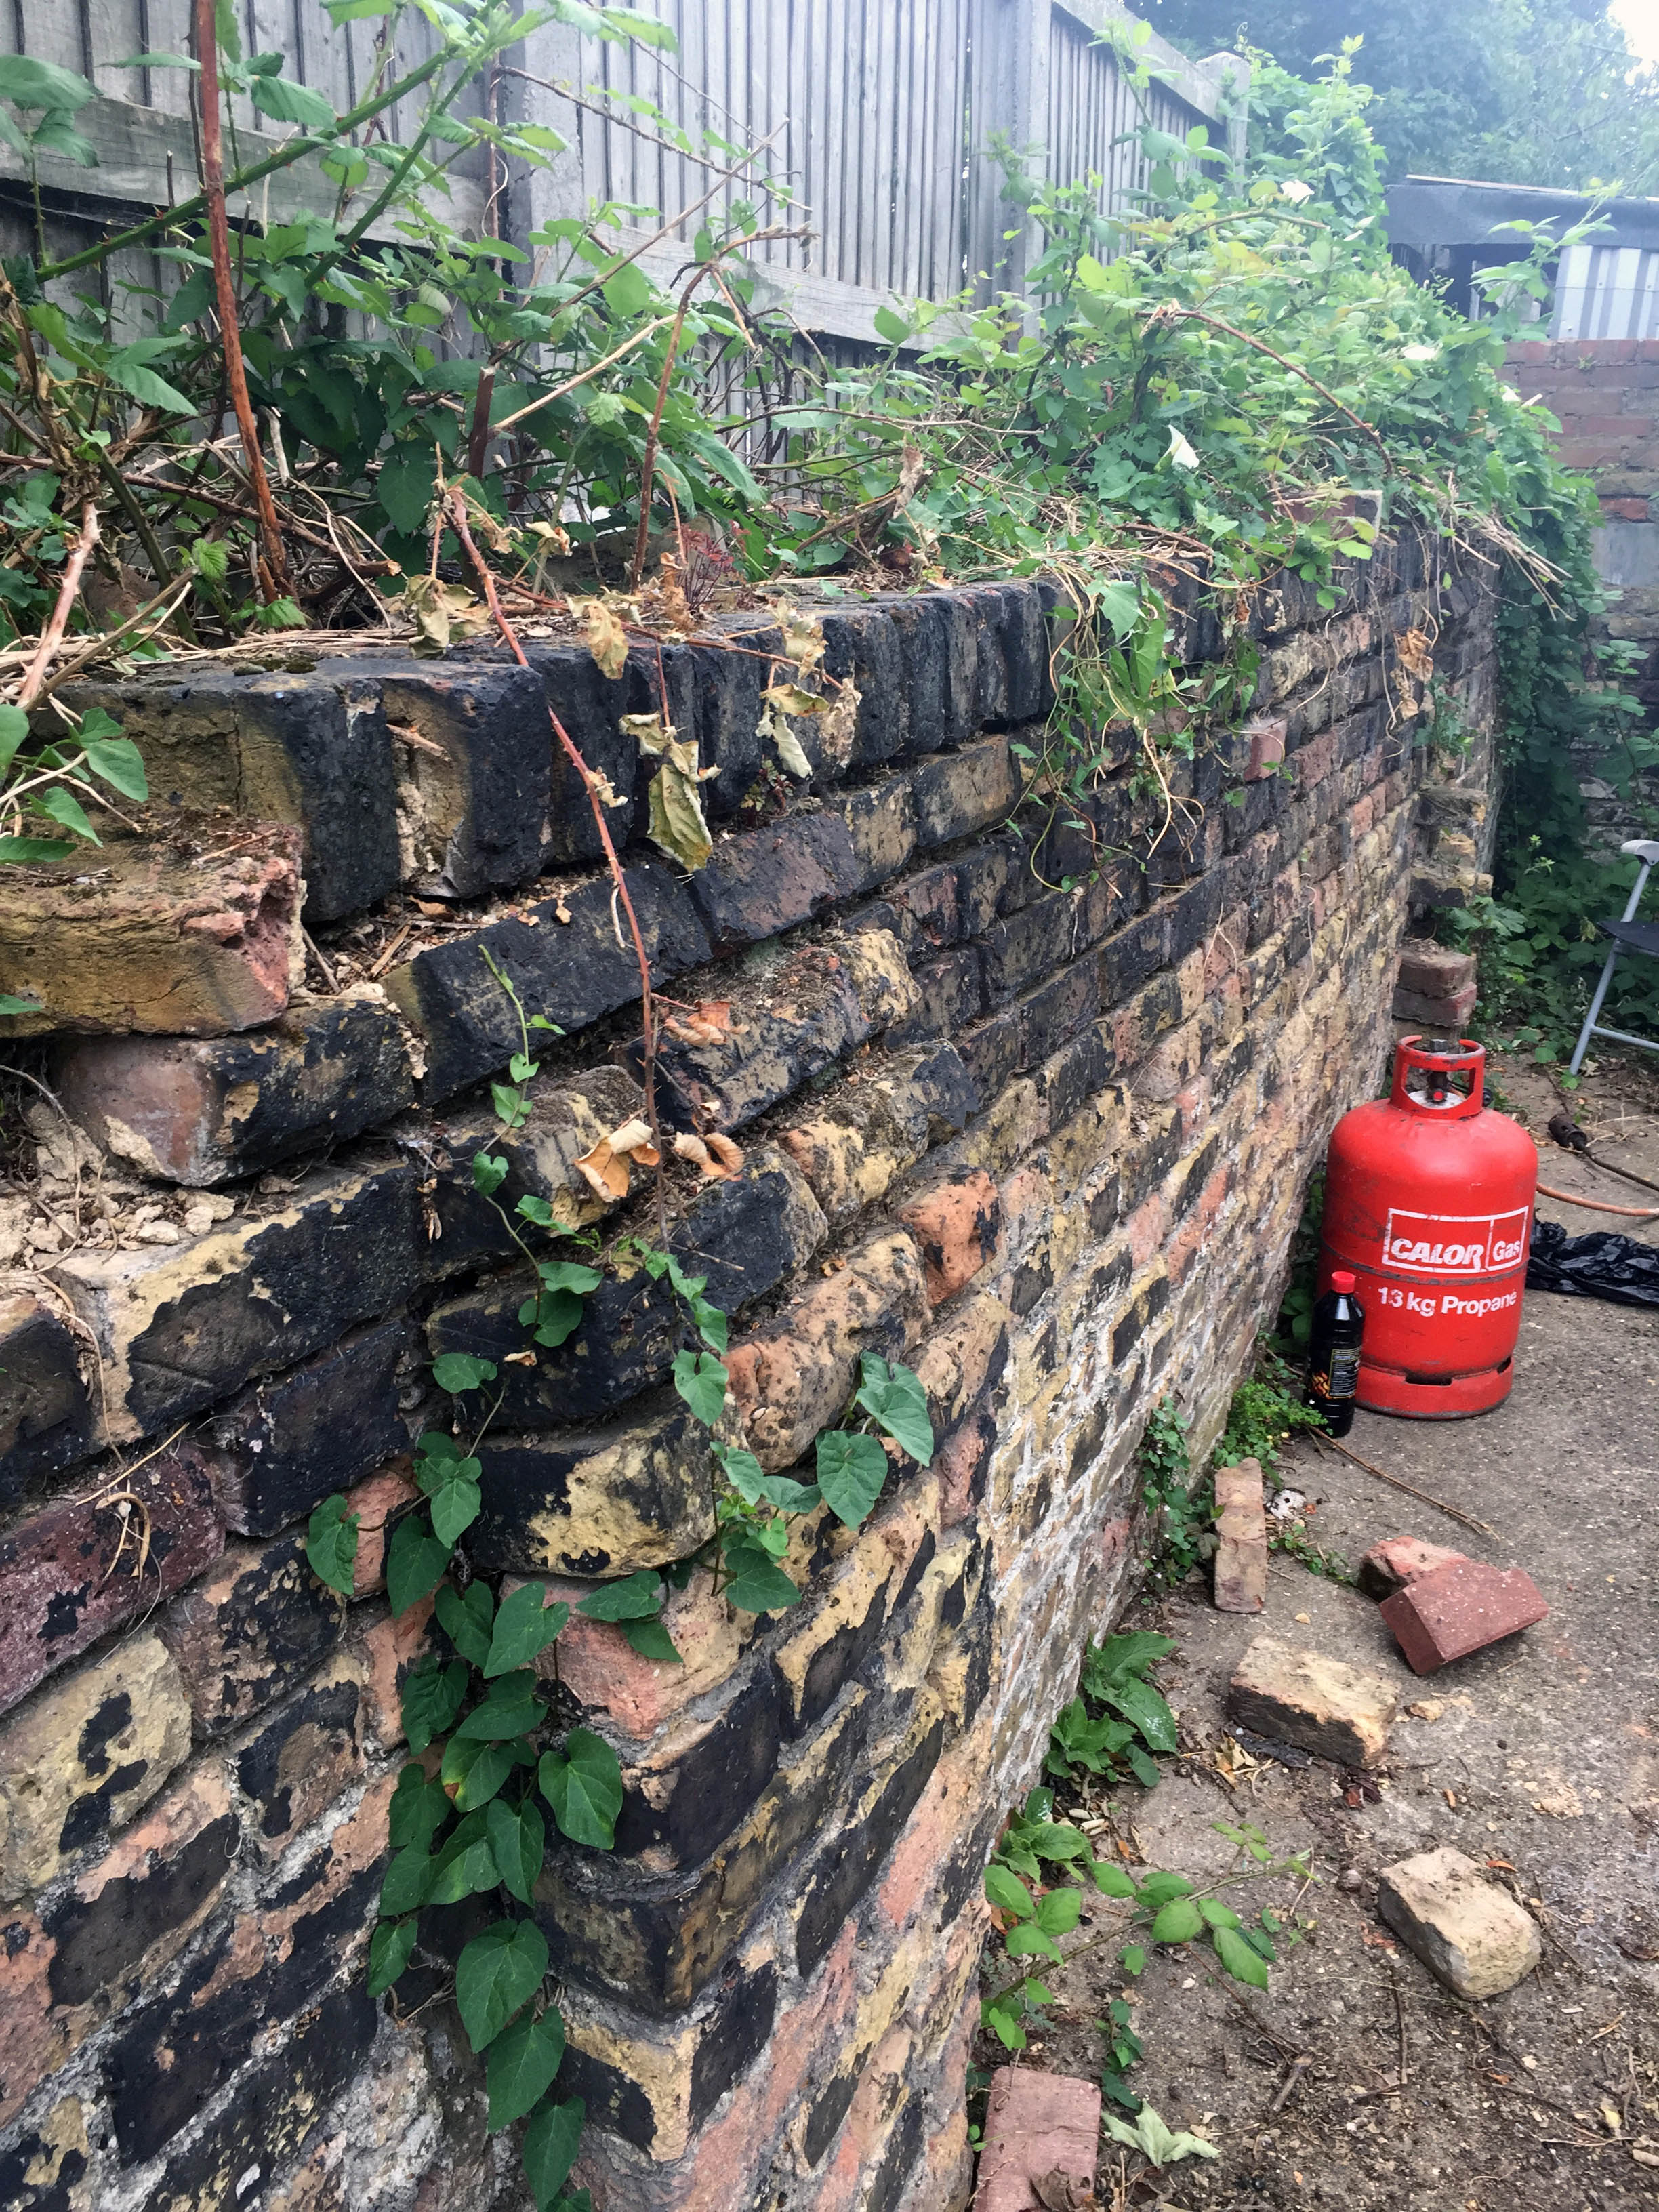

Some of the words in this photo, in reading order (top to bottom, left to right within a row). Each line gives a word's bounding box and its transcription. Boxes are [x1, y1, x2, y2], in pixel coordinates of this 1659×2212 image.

[1391, 1238, 1484, 1269] CALOR
[1492, 1240, 1521, 1261] Gas
[1441, 1290, 1517, 1317] Propane
